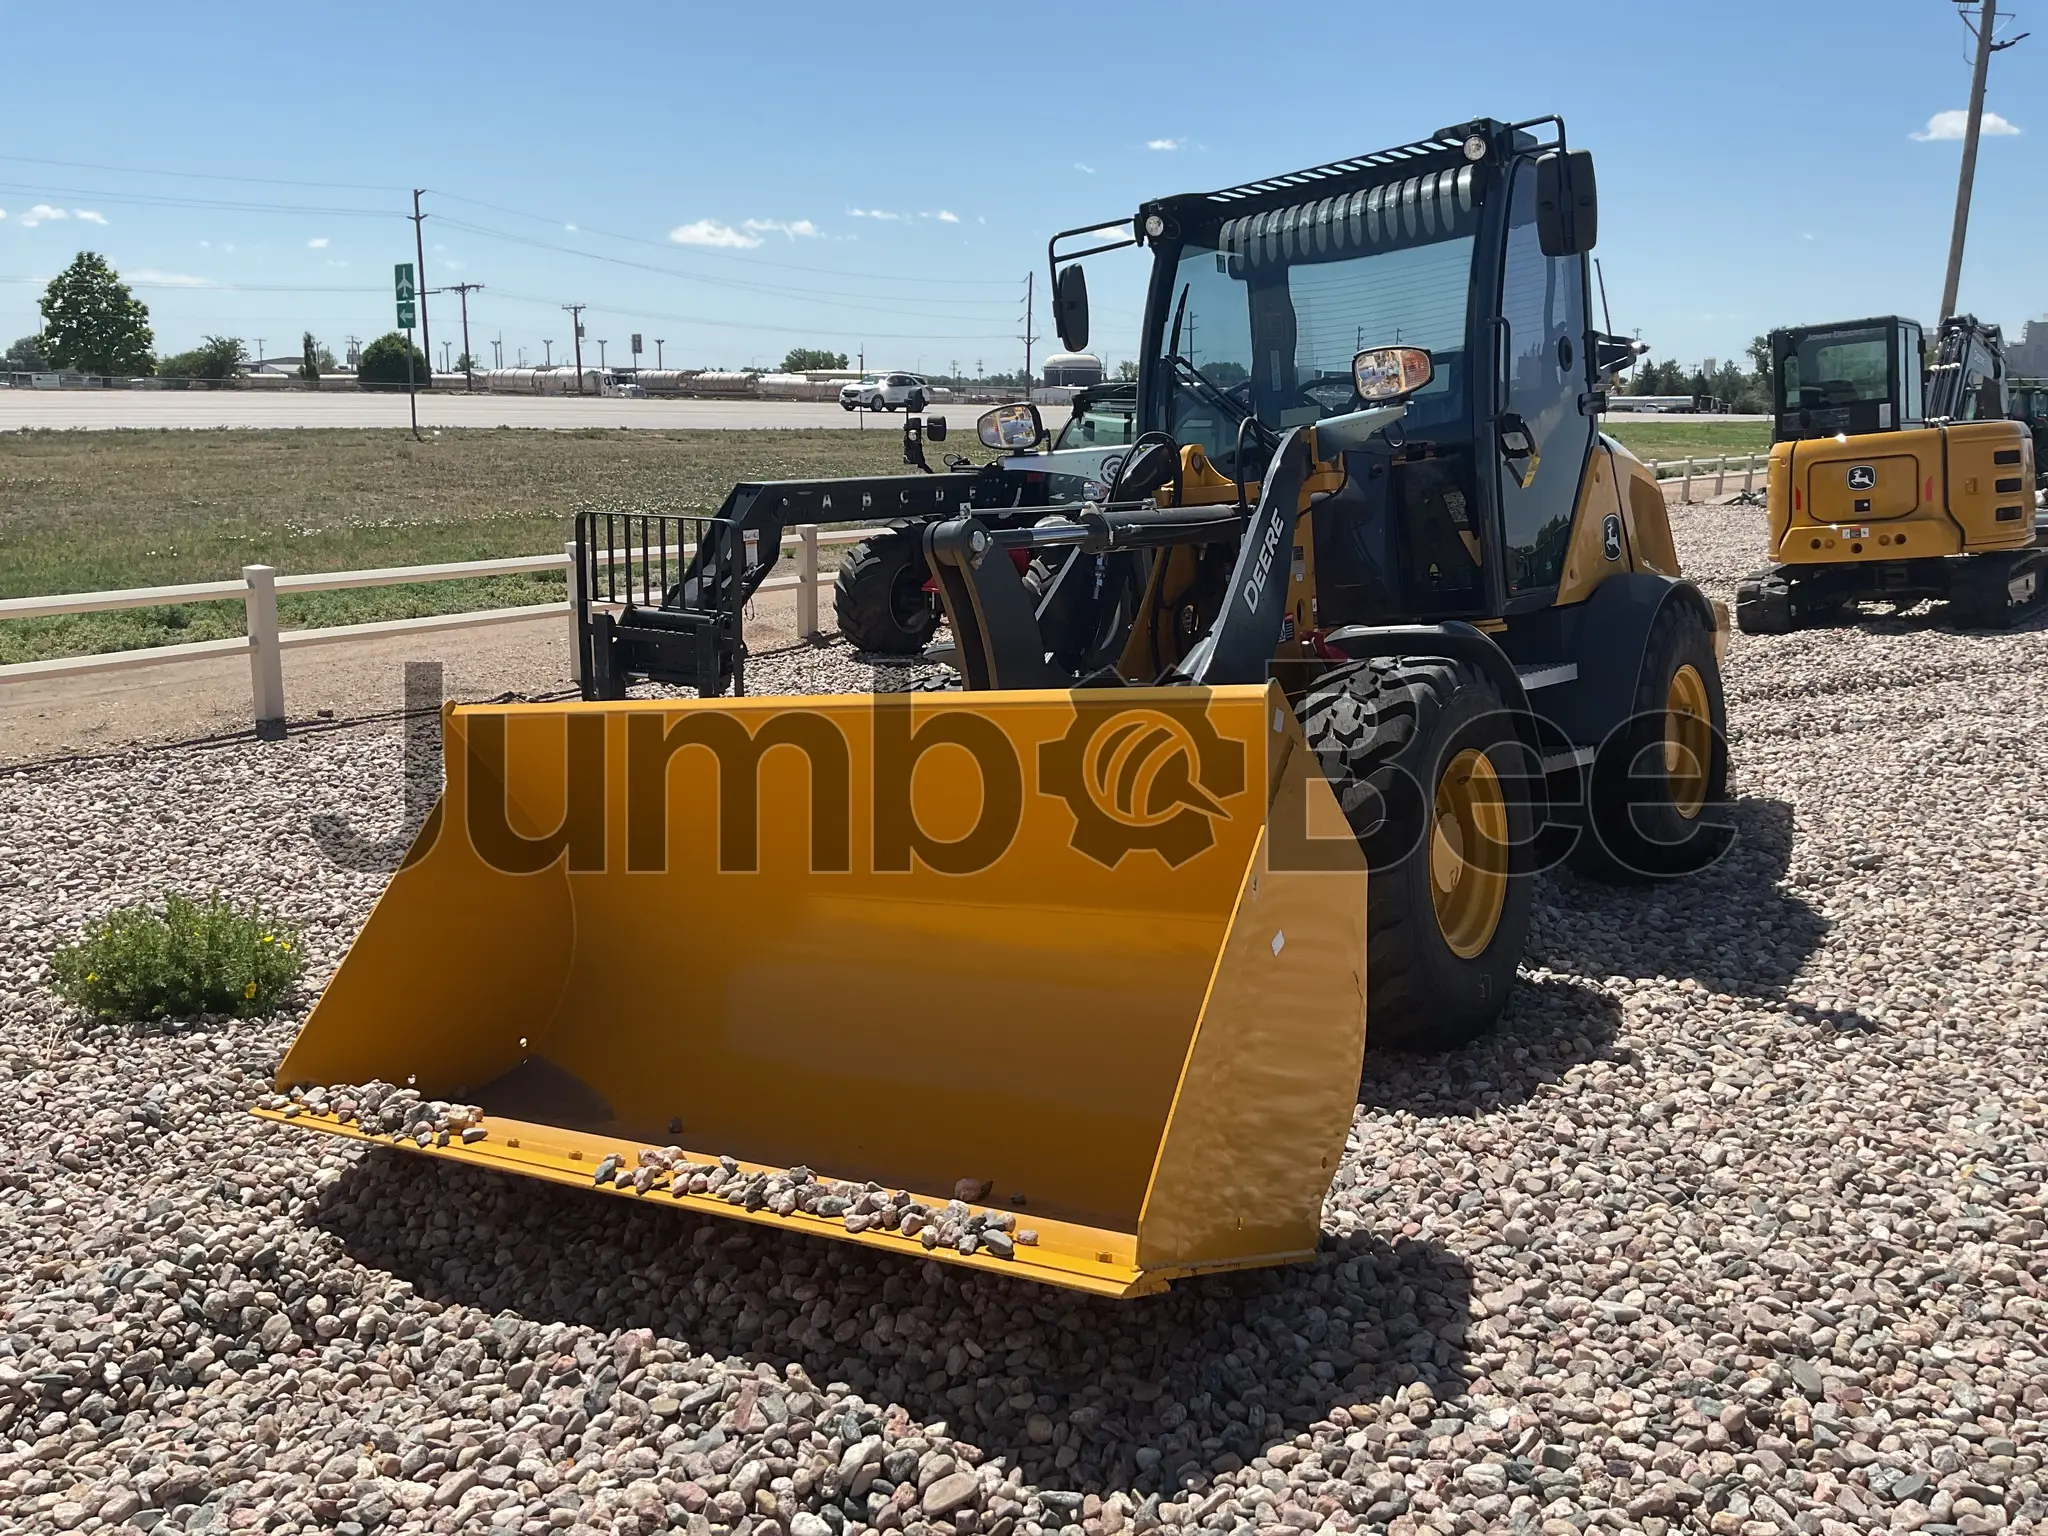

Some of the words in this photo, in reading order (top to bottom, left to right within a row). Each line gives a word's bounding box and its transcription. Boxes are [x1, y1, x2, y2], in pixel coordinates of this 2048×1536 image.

[822, 494, 832, 508] A
[900, 490, 909, 504] C
[1243, 507, 1285, 615] DEERE
